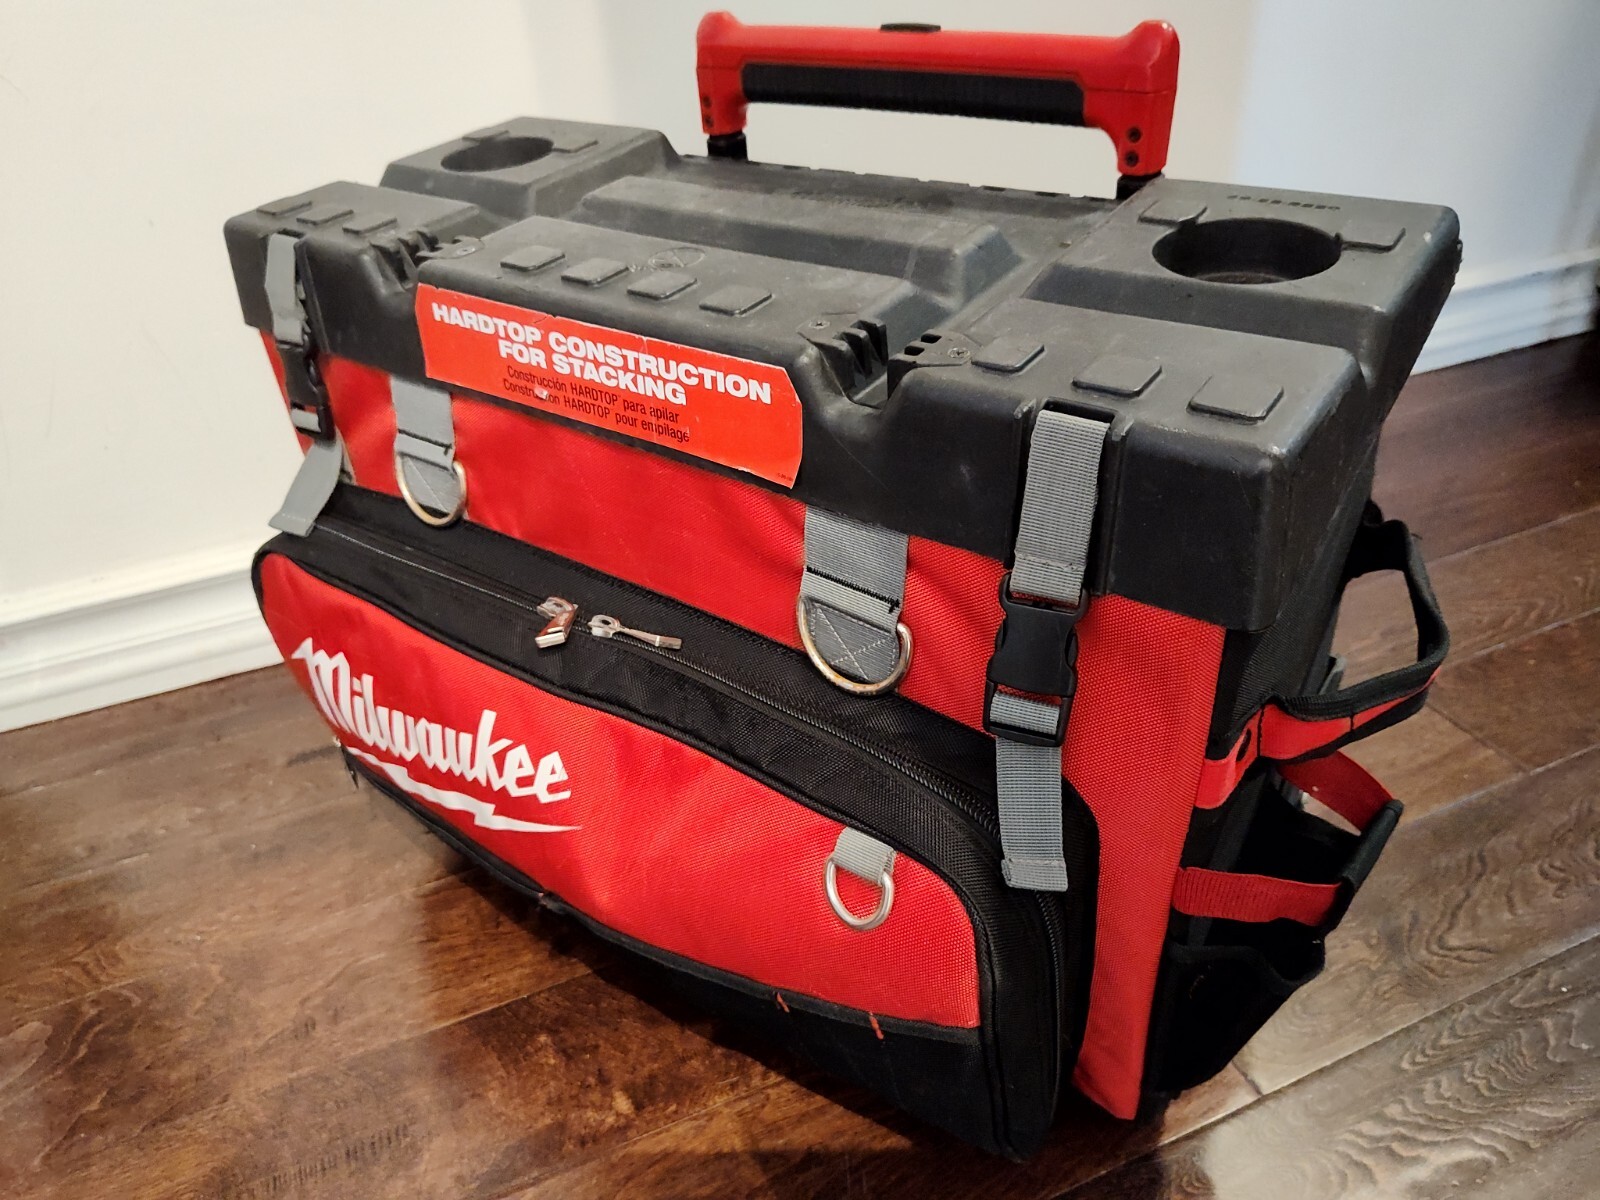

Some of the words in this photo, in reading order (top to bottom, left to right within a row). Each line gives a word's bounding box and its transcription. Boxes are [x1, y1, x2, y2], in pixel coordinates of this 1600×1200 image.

[431, 302, 542, 345] HARDTOP
[548, 331, 772, 405] CONSTRUCTION
[498, 338, 548, 369] FOR
[552, 353, 687, 407] STACKING
[503, 378, 561, 405] Construion
[564, 395, 611, 419] HARDTOP
[615, 412, 638, 428] pour
[641, 419, 690, 443] empilage
[507, 365, 568, 393] Construcción
[570, 382, 619, 408] HARDTOP
[623, 399, 647, 415] para
[649, 406, 680, 424] apilar
[291, 637, 572, 804] Milwaukee
